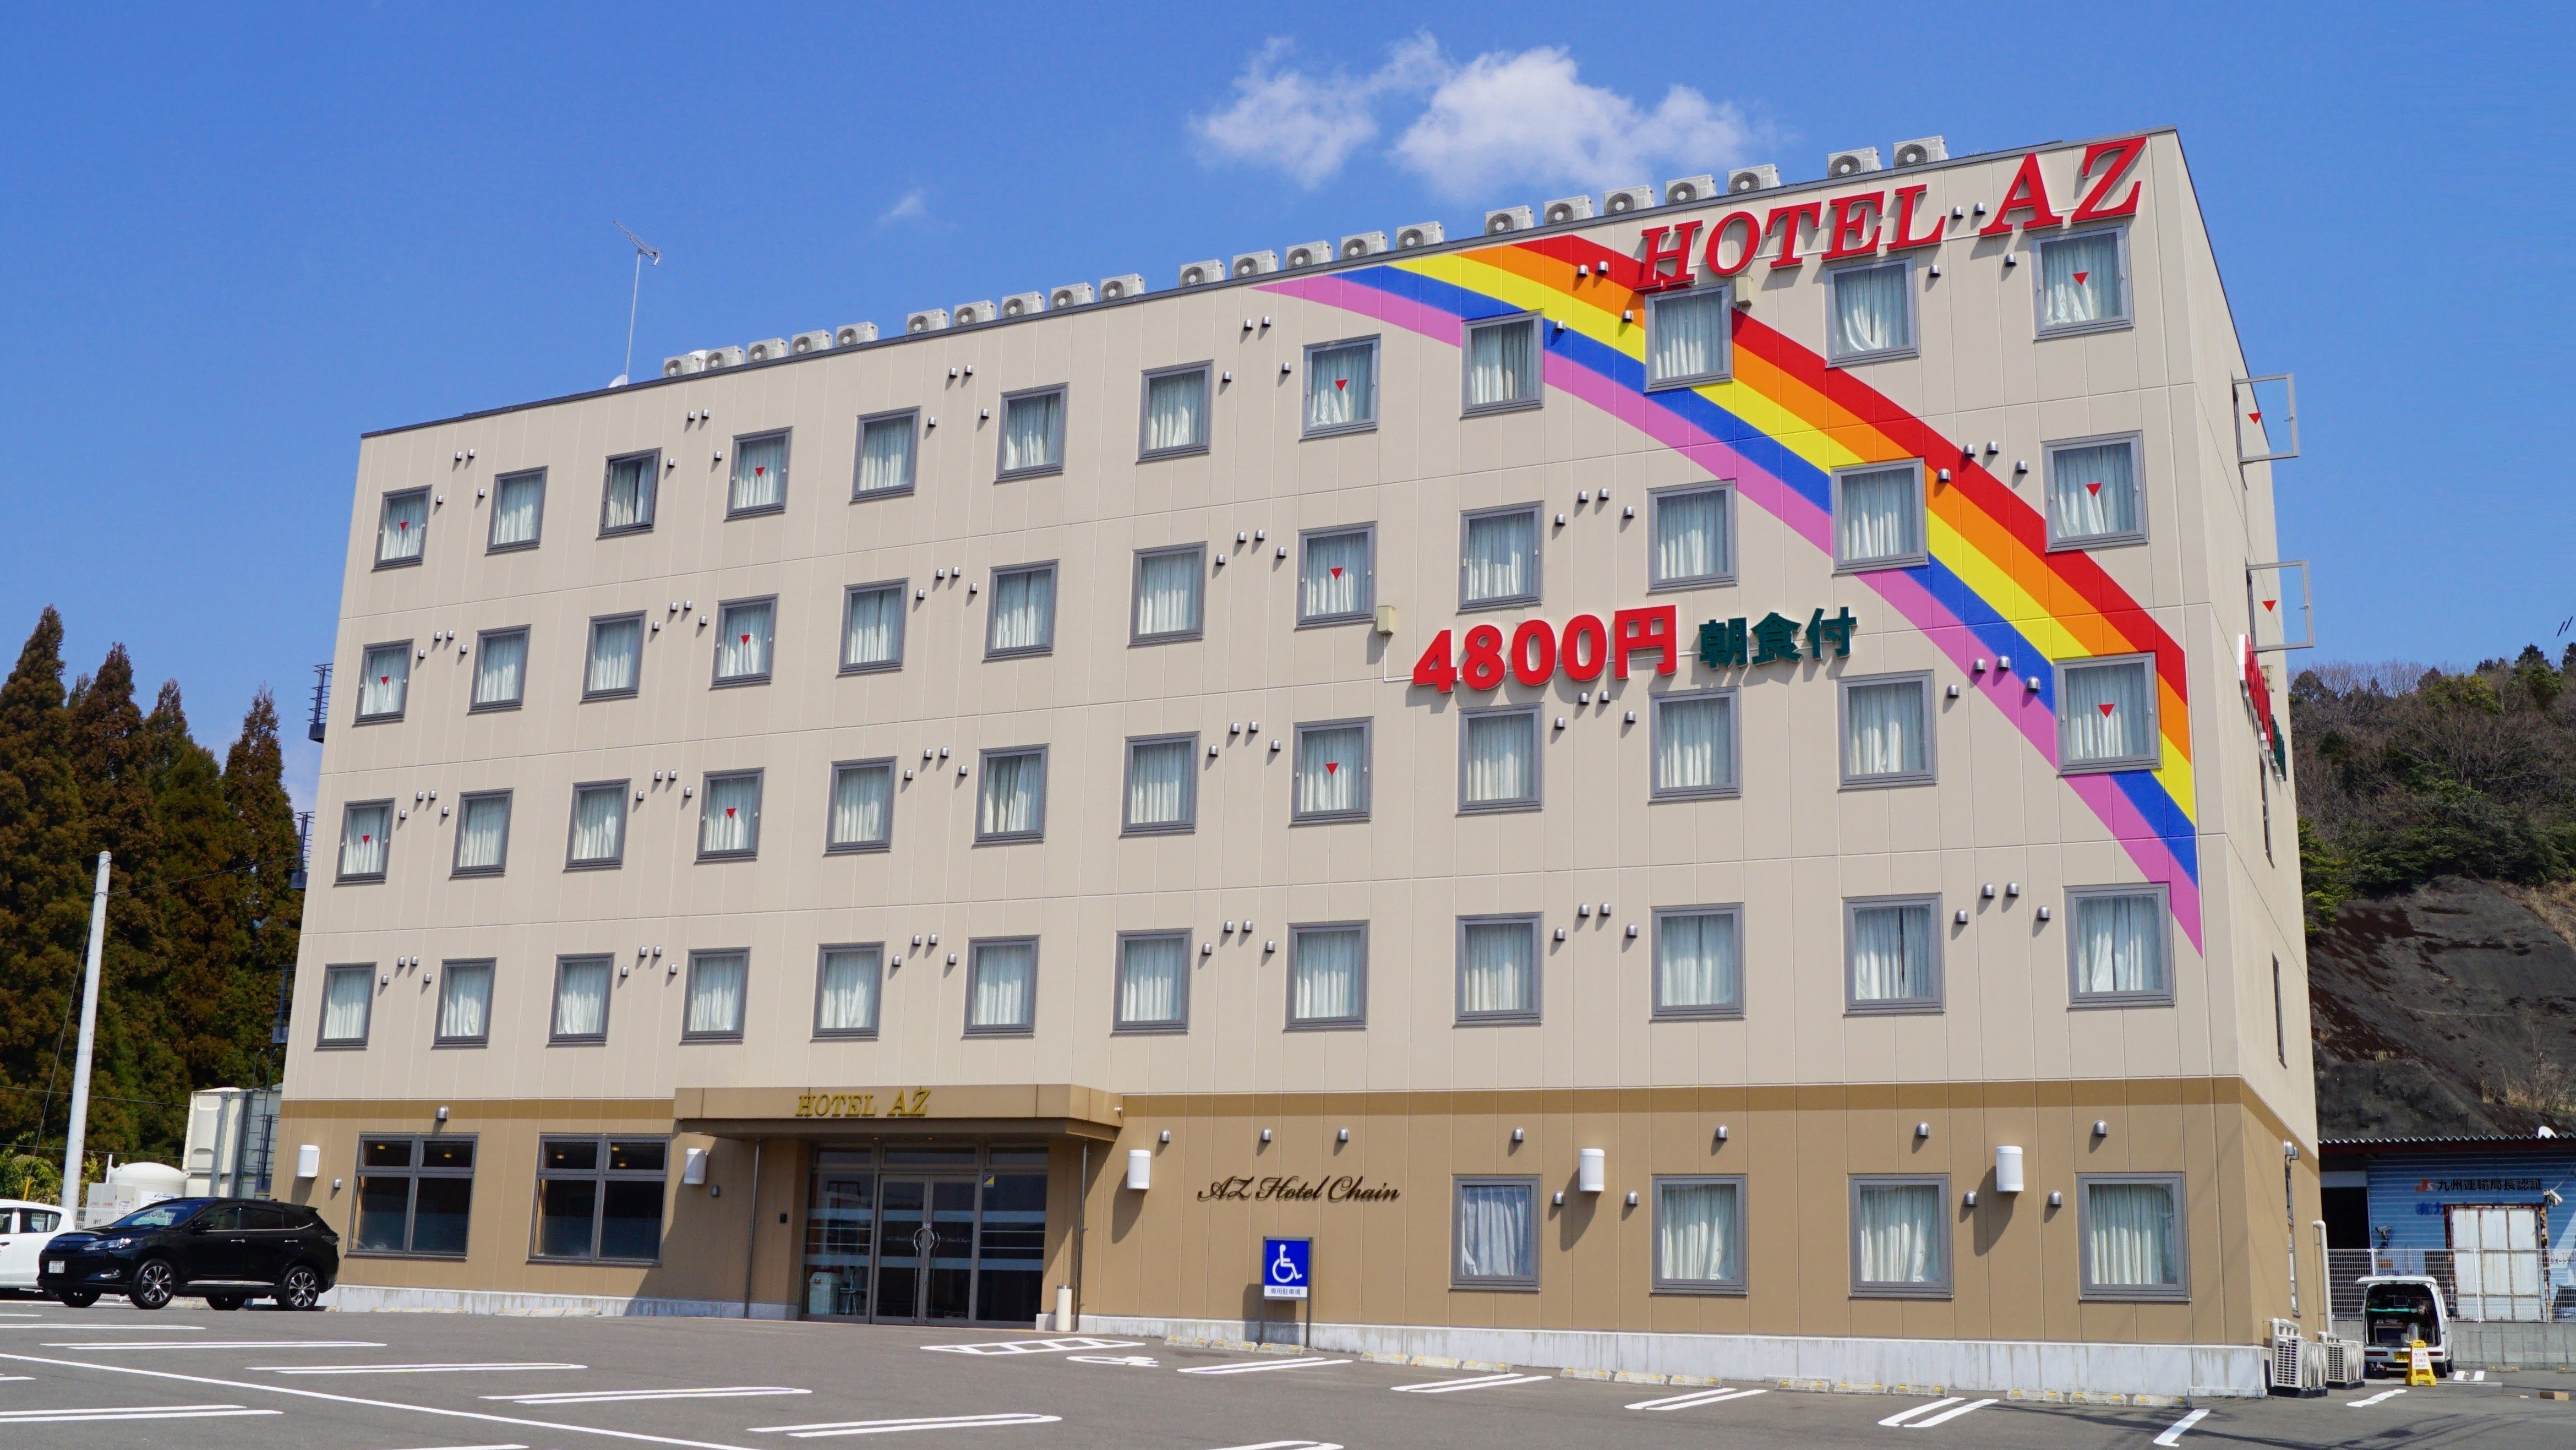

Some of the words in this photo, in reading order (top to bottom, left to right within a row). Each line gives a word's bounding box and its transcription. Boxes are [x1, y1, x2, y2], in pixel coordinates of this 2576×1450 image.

[1634, 184, 1947, 291] HOTEL
[1980, 136, 2147, 237] AZ
[1413, 604, 1680, 693] 4800円
[1699, 606, 1859, 670] 朝食付
[795, 1093, 877, 1117] HOTEL
[887, 1089, 931, 1117] AZ
[1197, 1175, 1255, 1201] AZ
[1256, 1175, 1331, 1201] Hotel
[1328, 1175, 1400, 1202] Chain
[2437, 1178, 2543, 1191] 九州運輸局長認証
